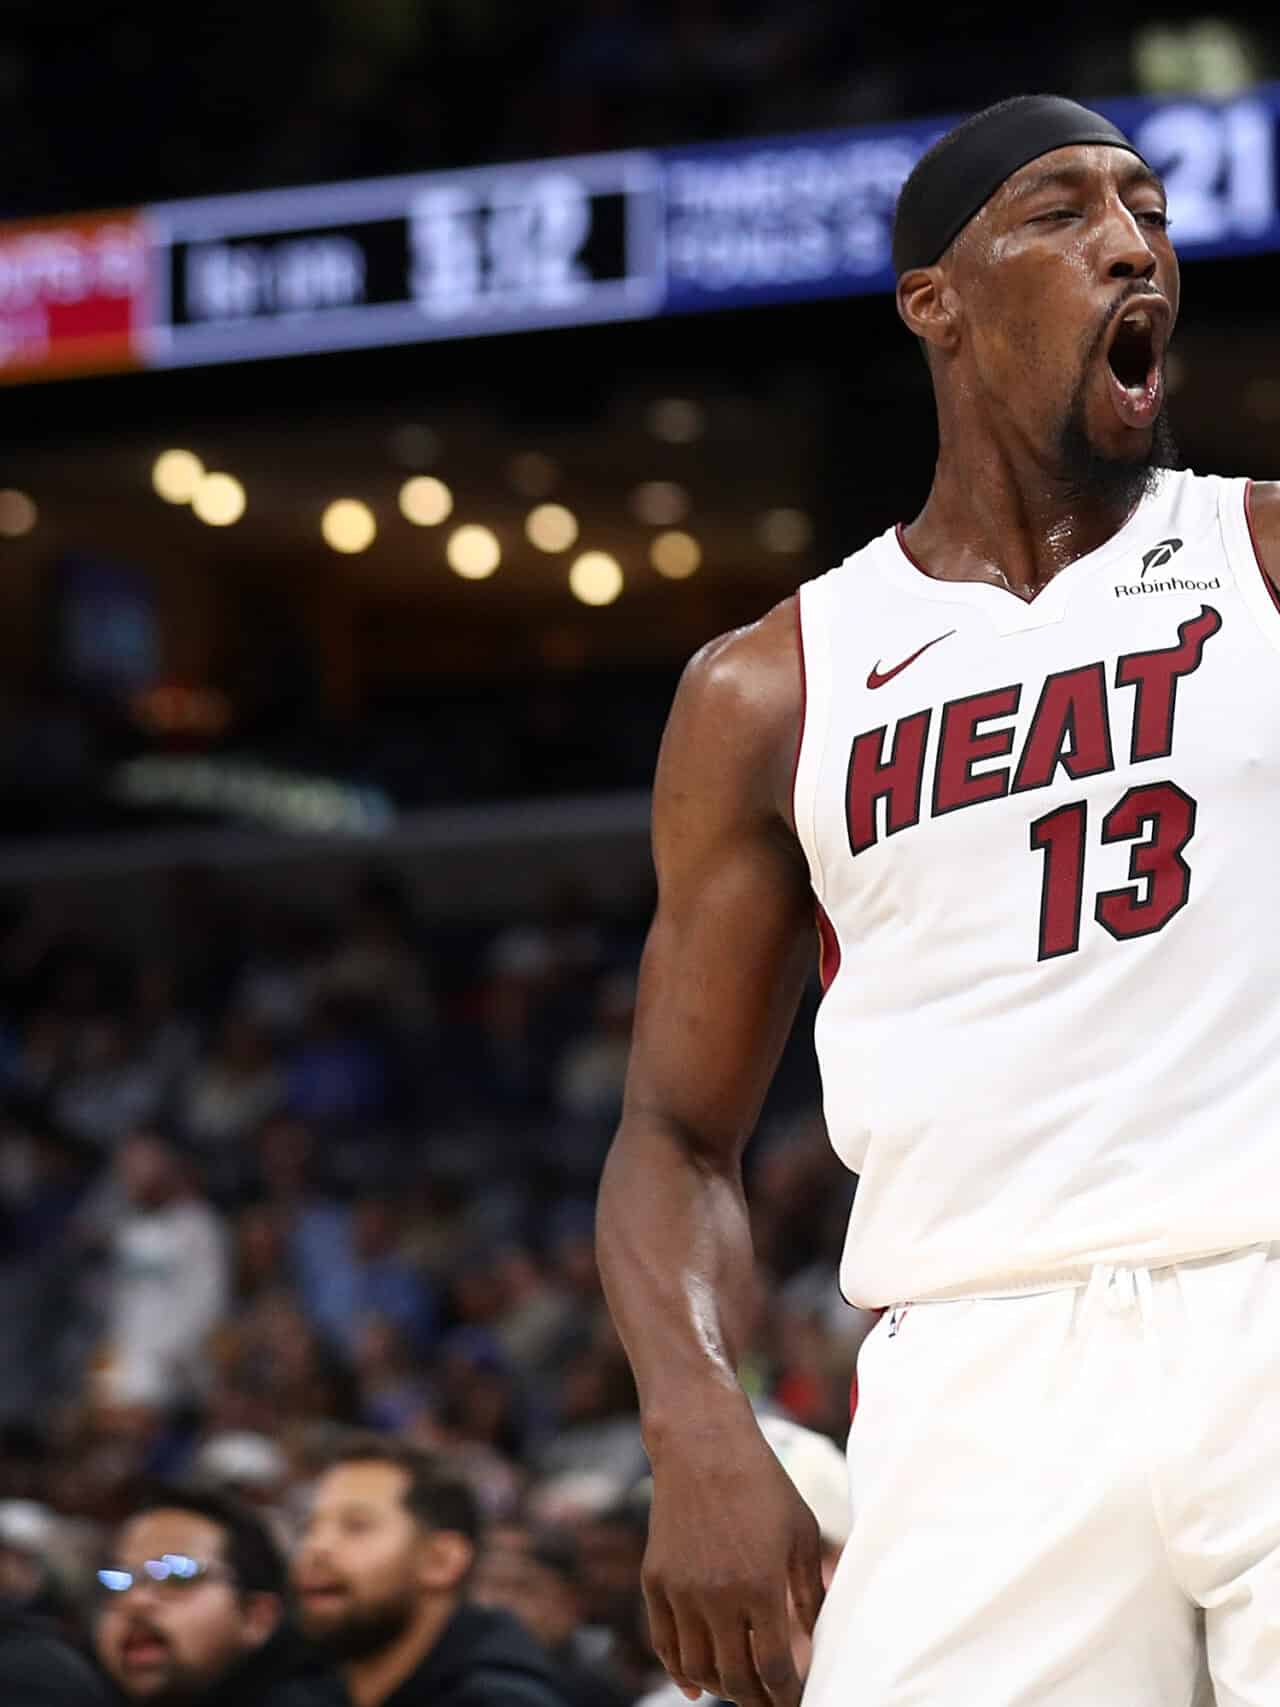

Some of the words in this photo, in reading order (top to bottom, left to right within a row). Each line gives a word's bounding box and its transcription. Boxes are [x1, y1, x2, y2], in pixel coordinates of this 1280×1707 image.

[1114, 577, 1221, 598] Robinhood
[846, 604, 1222, 857] HEAT
[1030, 780, 1198, 962] 13
